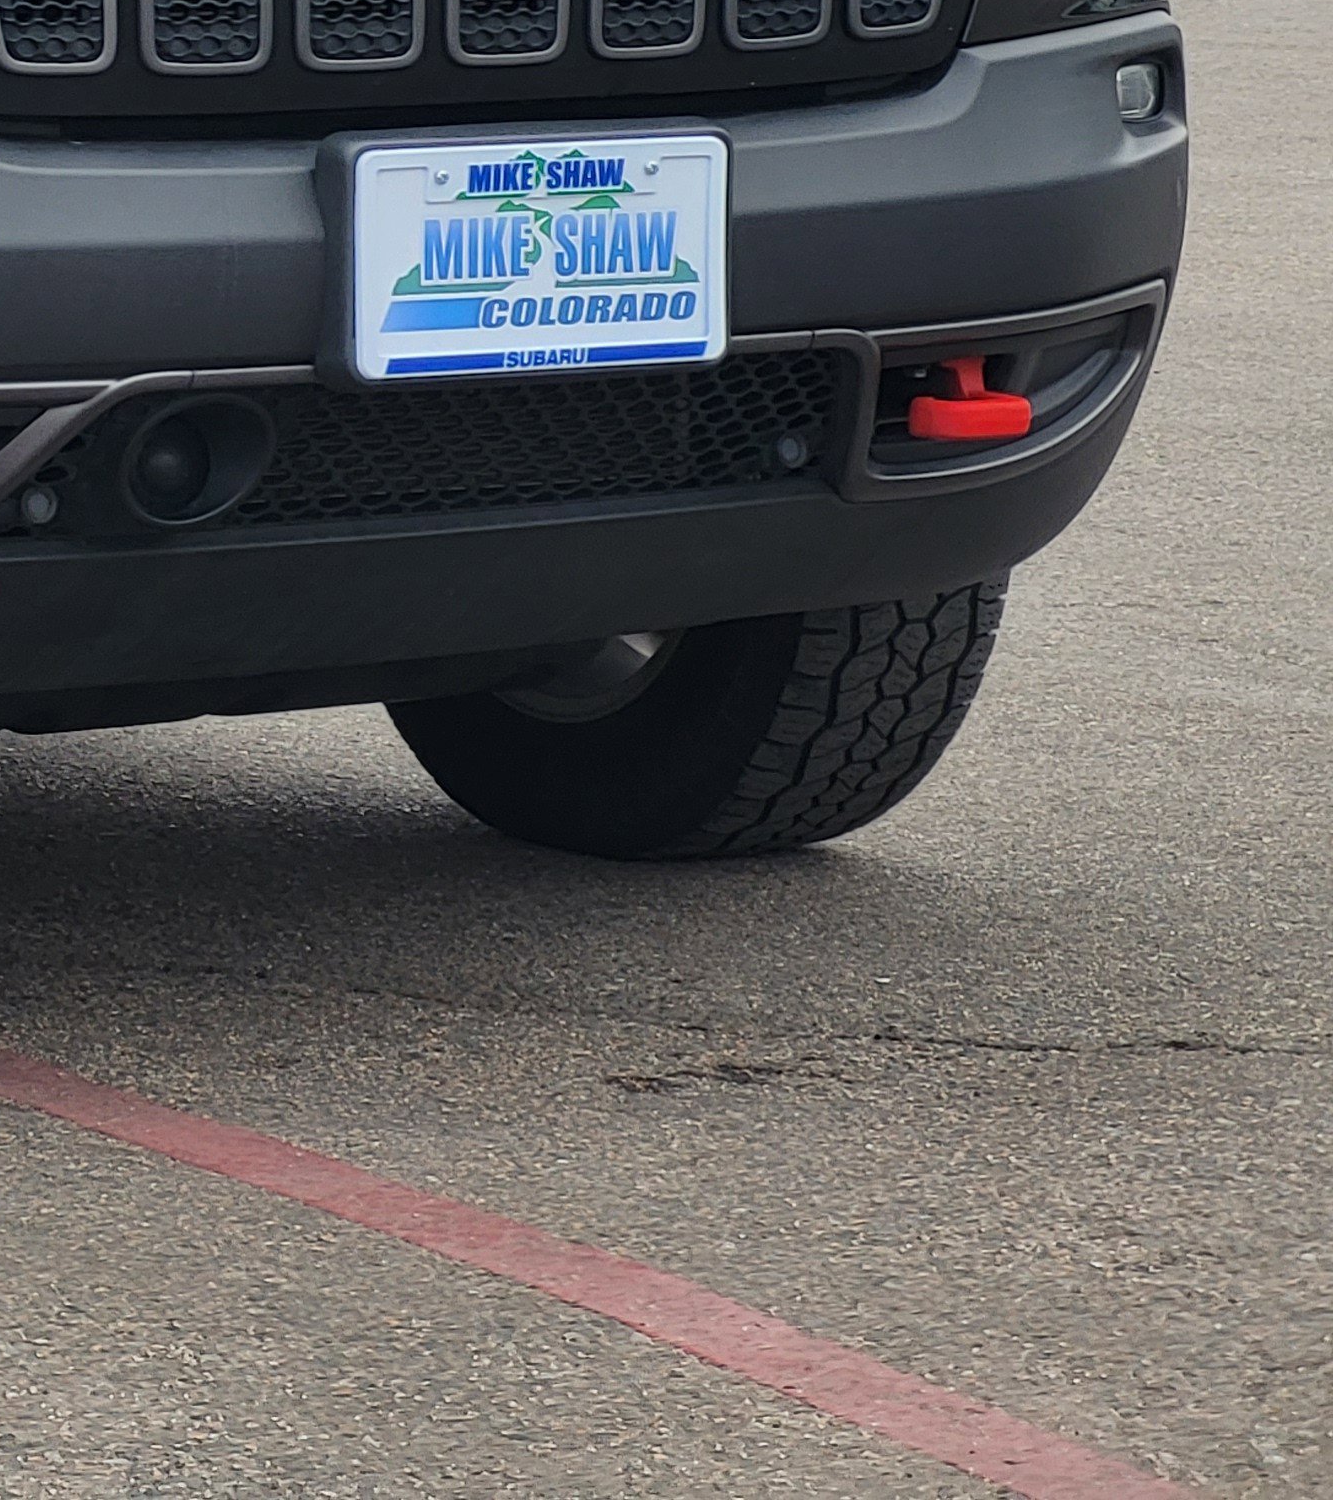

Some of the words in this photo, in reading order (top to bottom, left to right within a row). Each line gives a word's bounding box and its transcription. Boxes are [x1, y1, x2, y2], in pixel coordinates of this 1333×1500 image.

[468, 160, 534, 193] MIKE
[546, 157, 625, 190] SHAW
[423, 214, 532, 282] MIKE
[553, 210, 677, 277] SHAW
[479, 290, 698, 329] COLORADO
[505, 347, 586, 368] SUBARU
